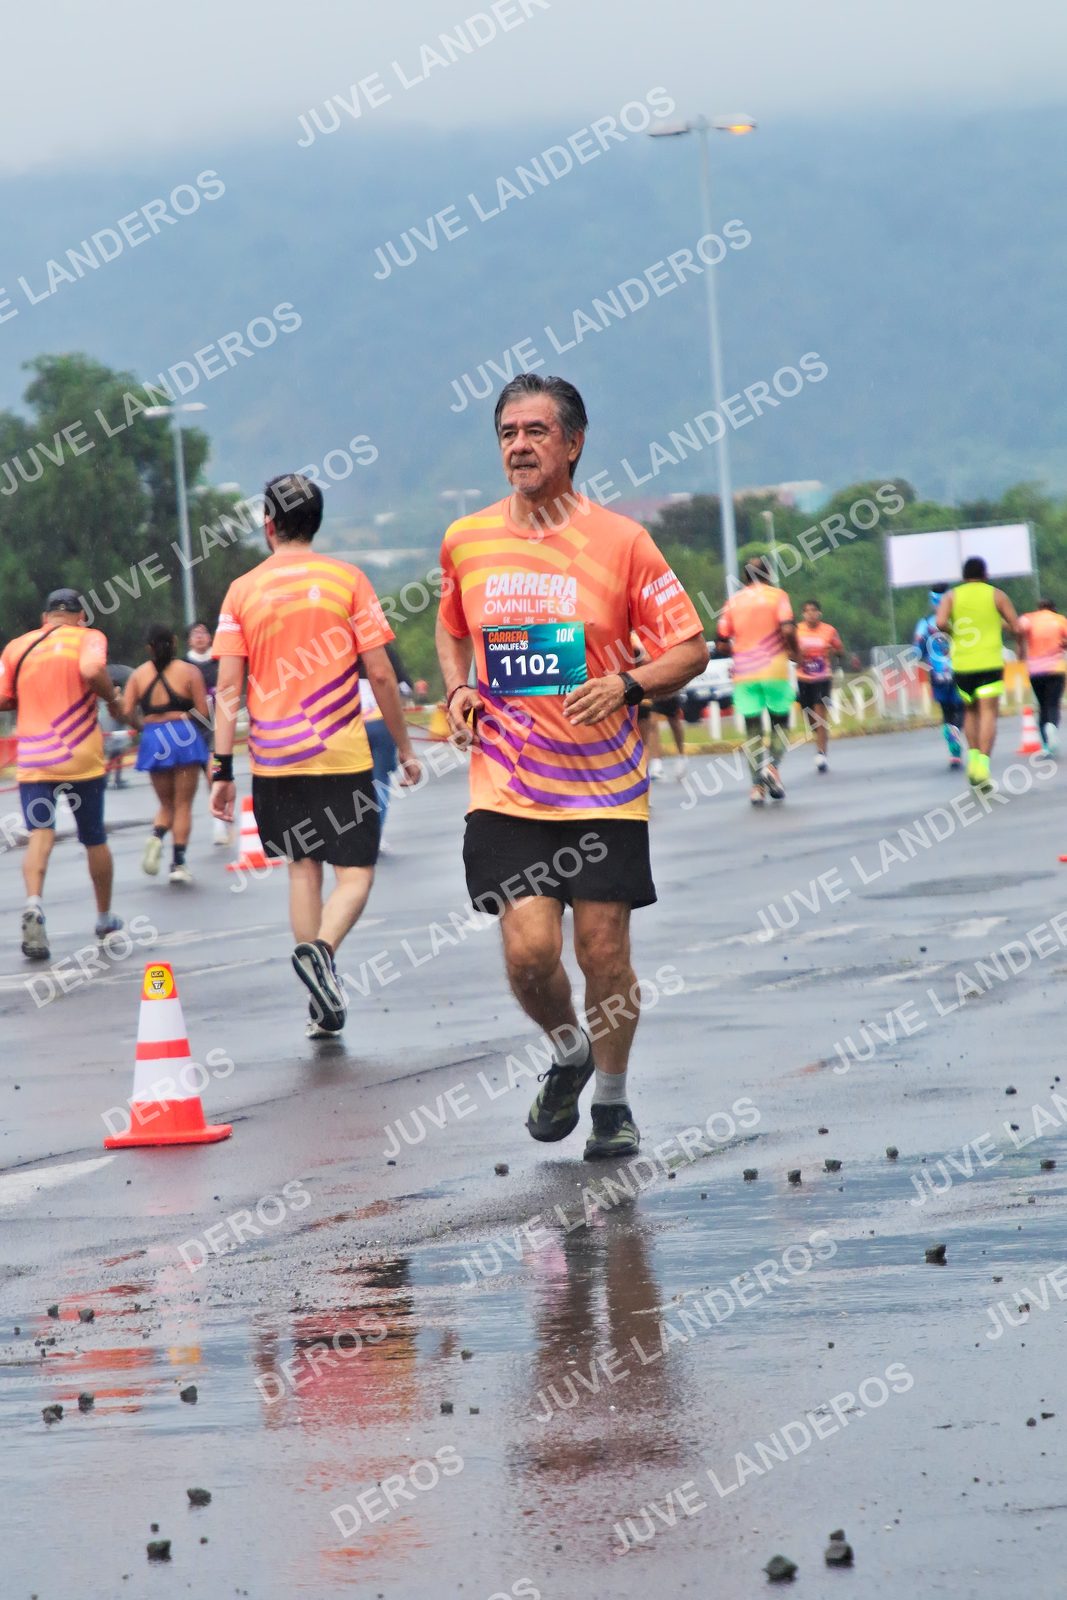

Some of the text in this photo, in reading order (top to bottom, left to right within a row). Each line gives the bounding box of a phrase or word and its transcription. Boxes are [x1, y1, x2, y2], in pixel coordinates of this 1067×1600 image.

[486, 573, 576, 598] CARRERA
[484, 598, 556, 614] OMNILIFE
[488, 631, 528, 642] CARRERA
[556, 628, 575, 643] 10K
[489, 643, 520, 651] OMNILIFE
[500, 654, 560, 676] 1102
